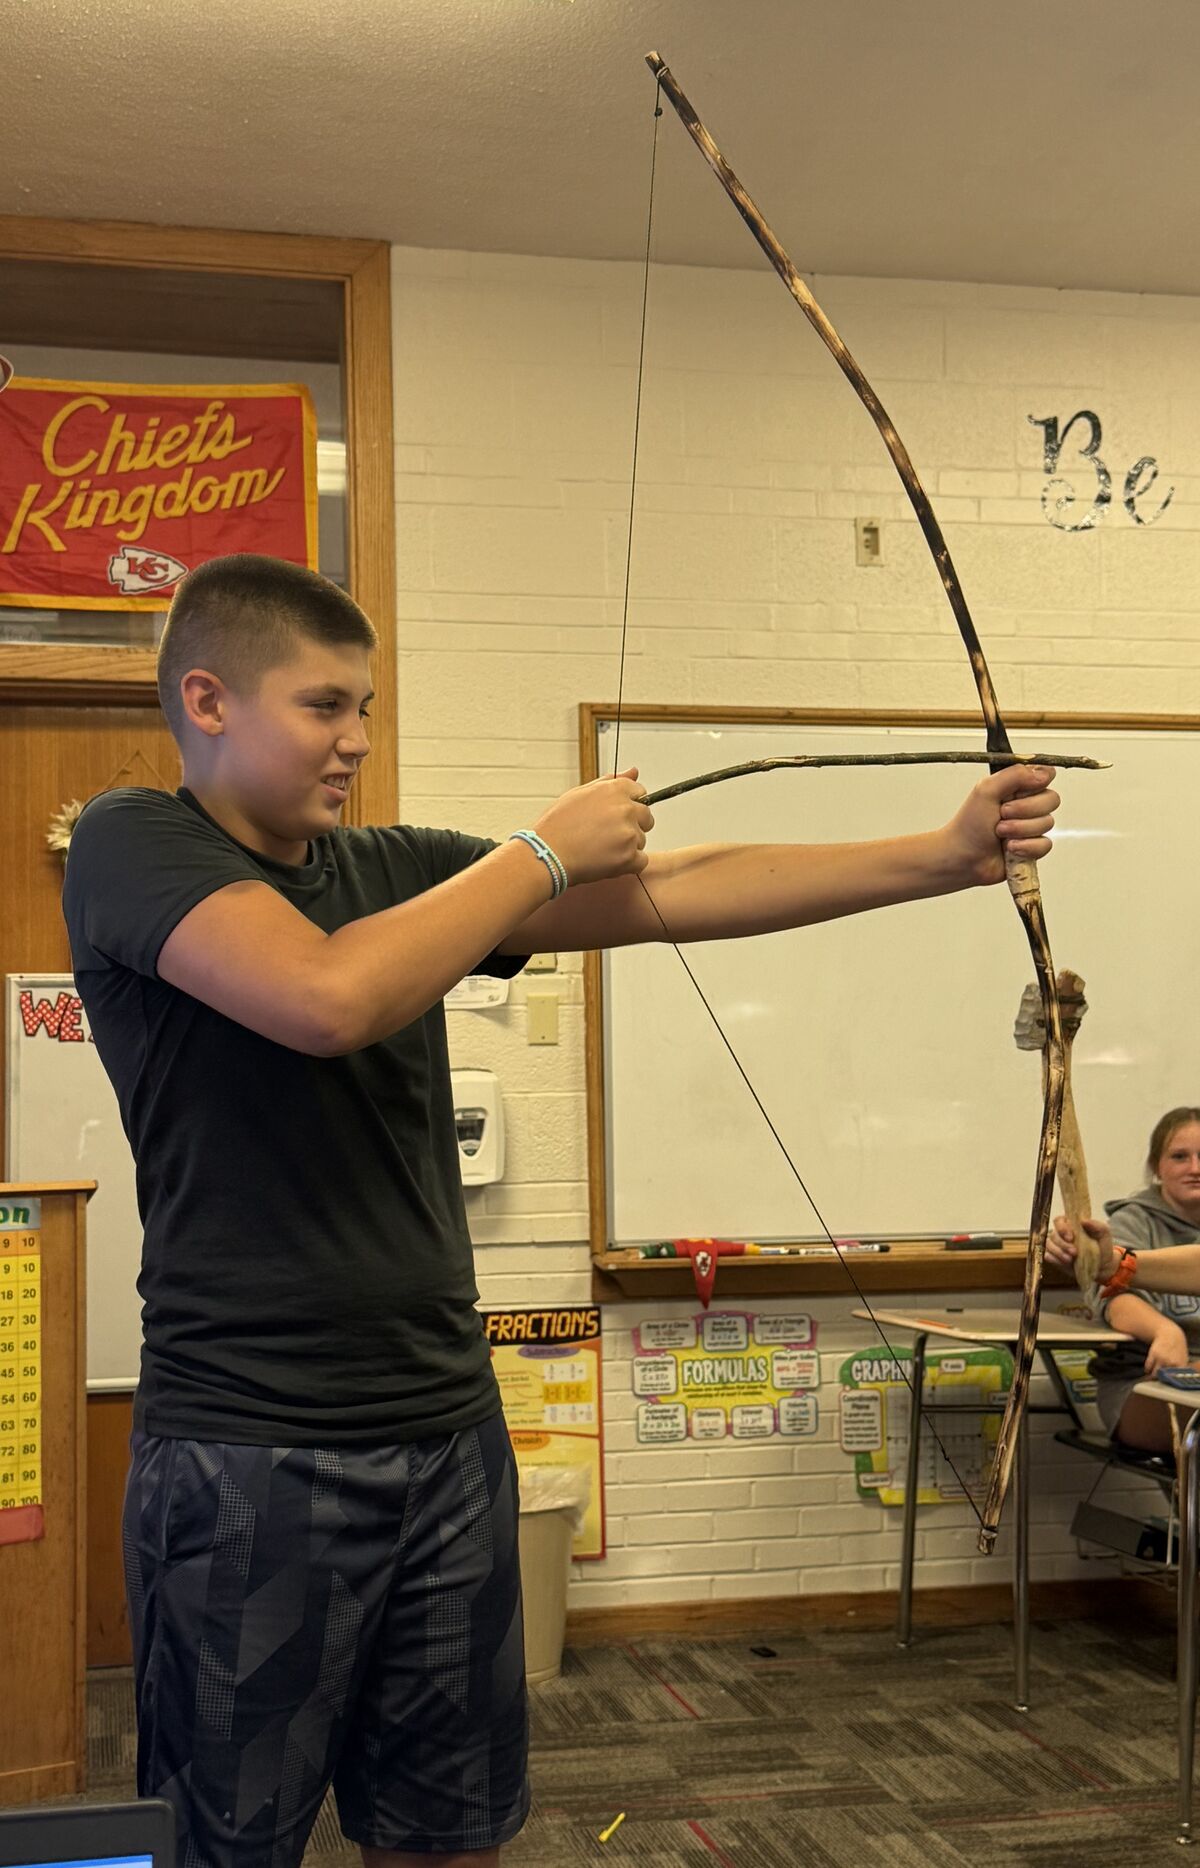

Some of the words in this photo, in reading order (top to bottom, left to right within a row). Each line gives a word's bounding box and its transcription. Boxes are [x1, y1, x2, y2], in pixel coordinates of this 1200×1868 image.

[42, 396, 252, 477] Chiefs
[1027, 410, 1174, 532] Be
[2, 467, 286, 553] Kingdom
[127, 556, 169, 583] KC
[20, 990, 93, 1042] WE
[2, 1238, 10, 1248] 9
[22, 1236, 35, 1247] 10
[3, 1264, 11, 1274] 9
[23, 1262, 35, 1273] 10
[0, 1290, 13, 1300] 18
[22, 1288, 36, 1298] 20
[0, 1316, 14, 1327] 27
[23, 1314, 36, 1325] 30
[485, 1310, 599, 1340] FRACTIONS
[23, 1340, 36, 1350] 40
[0, 1368, 14, 1378] 45
[23, 1366, 36, 1377] 50
[682, 1357, 768, 1385] FORMULAS
[23, 1392, 36, 1402] 60
[1, 1420, 15, 1431] 63
[23, 1418, 36, 1429] 70
[1, 1446, 15, 1457] 72
[22, 1444, 36, 1455] 80
[1, 1473, 14, 1483] 81
[22, 1470, 36, 1480] 90
